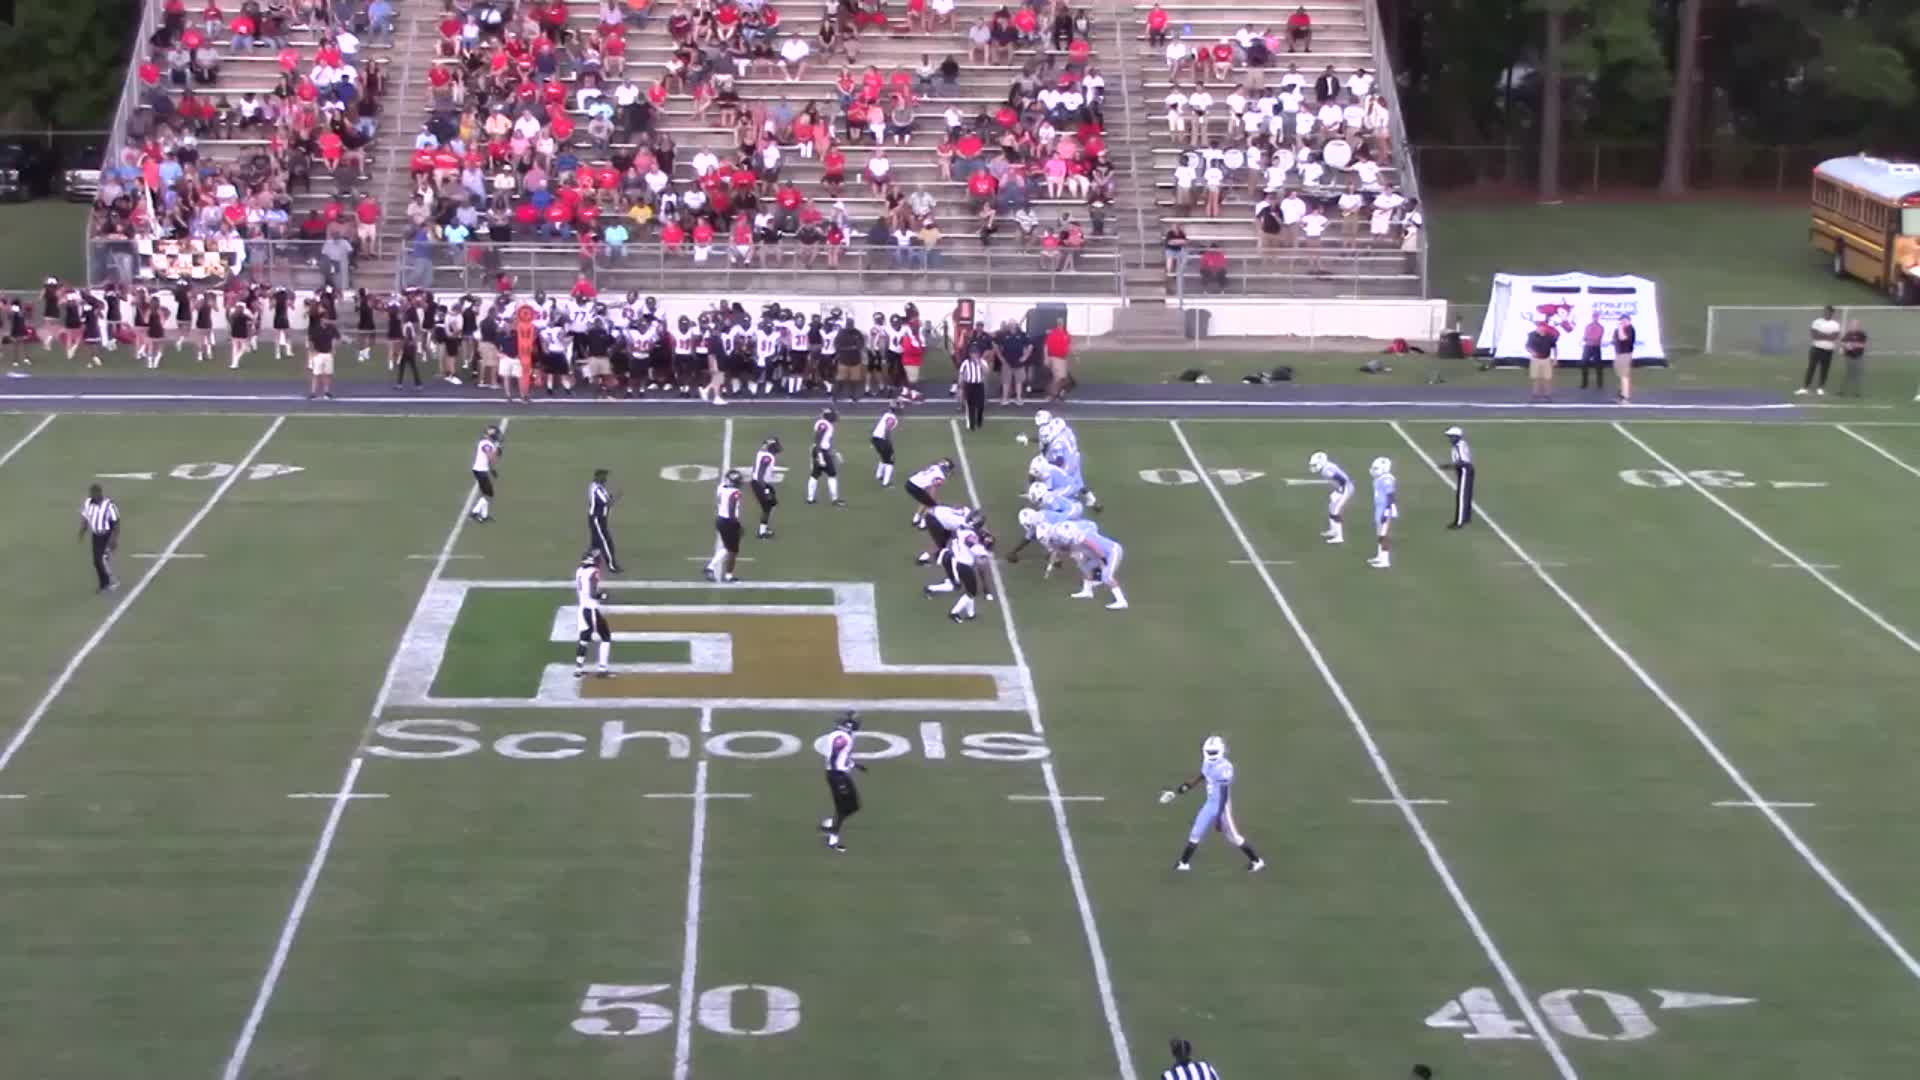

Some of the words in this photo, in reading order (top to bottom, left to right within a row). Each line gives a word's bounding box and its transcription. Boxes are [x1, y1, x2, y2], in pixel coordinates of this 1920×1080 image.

[1138, 467, 1267, 485] 40
[1618, 469, 1756, 489] 30
[366, 719, 1051, 760] Schools
[571, 984, 801, 1037] 50
[1425, 986, 1657, 1041] 40
